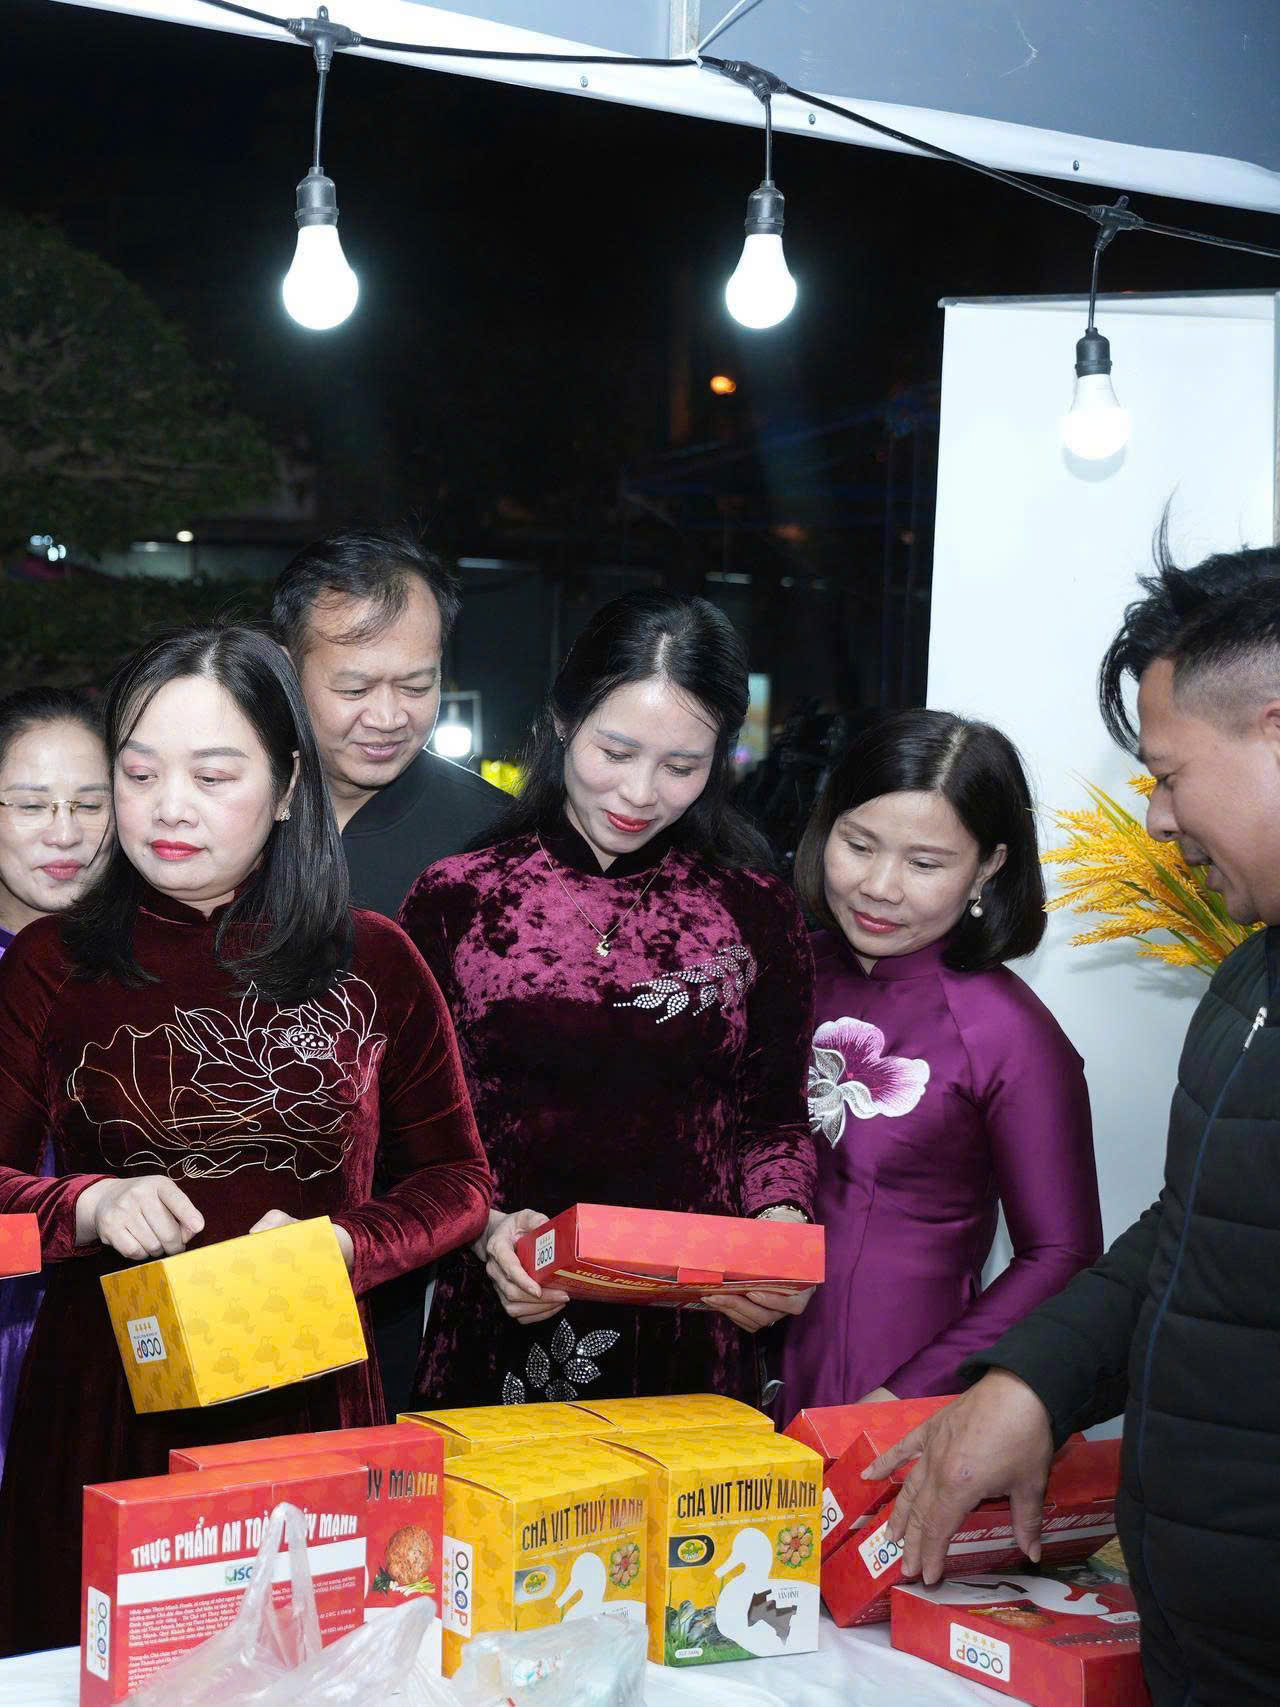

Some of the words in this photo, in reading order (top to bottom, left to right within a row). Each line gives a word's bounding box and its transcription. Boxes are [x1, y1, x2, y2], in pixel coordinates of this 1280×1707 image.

[136, 1337, 162, 1360] OCOP
[710, 1481, 732, 1519] VỊT
[777, 1478, 817, 1512] MẠNH
[131, 1537, 171, 1569] THỰC
[174, 1516, 218, 1560] PHẨM
[222, 1520, 241, 1552] AN
[319, 1513, 358, 1541] MẠNH
[551, 1506, 570, 1546] VỊT
[455, 1551, 469, 1626] OCOP
[97, 1602, 108, 1671] OCOP
[956, 1644, 1003, 1675] OCOP
